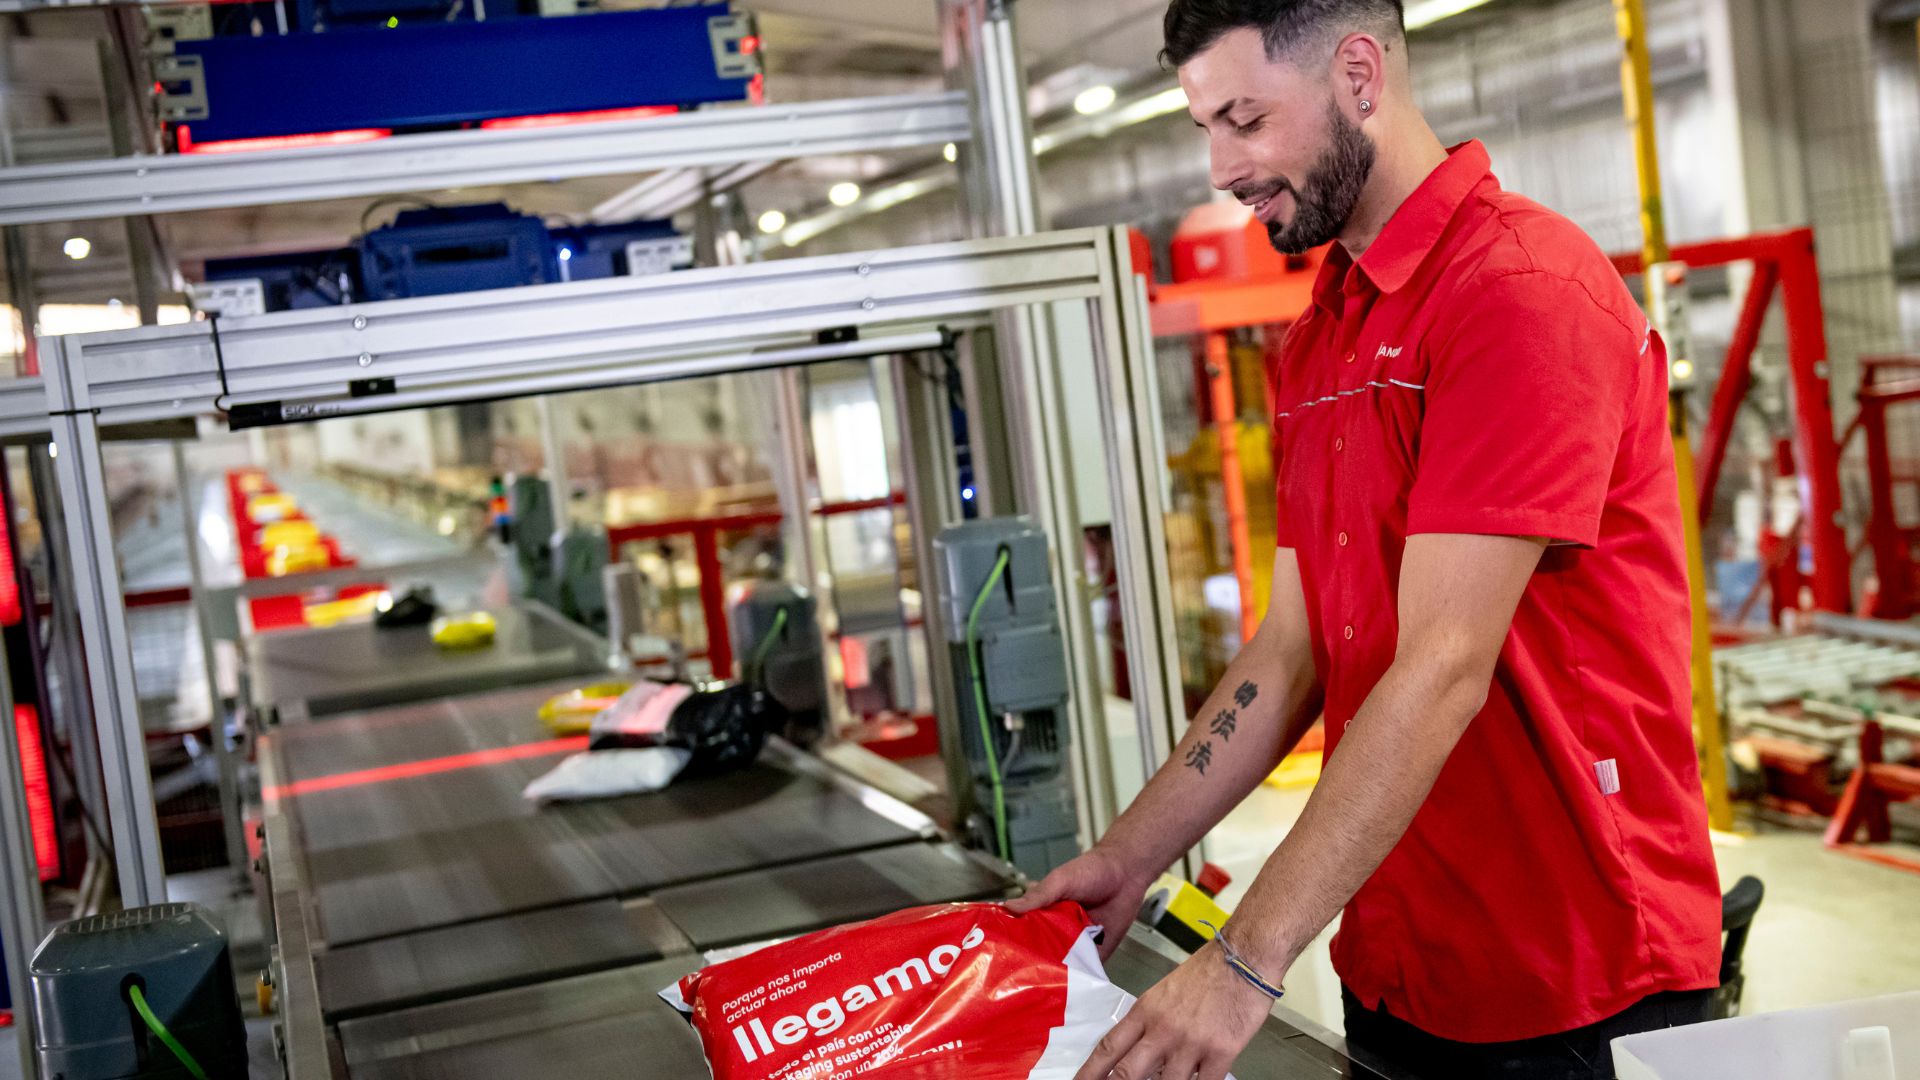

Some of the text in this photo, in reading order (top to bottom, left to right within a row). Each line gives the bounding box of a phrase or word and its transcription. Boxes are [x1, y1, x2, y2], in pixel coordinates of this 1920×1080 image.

[722, 952, 842, 1014] Porque nos importa
[726, 980, 807, 1024] actuar ahora
[732, 926, 985, 1064] llegamos
[817, 1037, 846, 1058] país
[848, 1030, 873, 1045] con
[875, 1022, 894, 1035] un
[835, 1023, 912, 1066] sustentable
